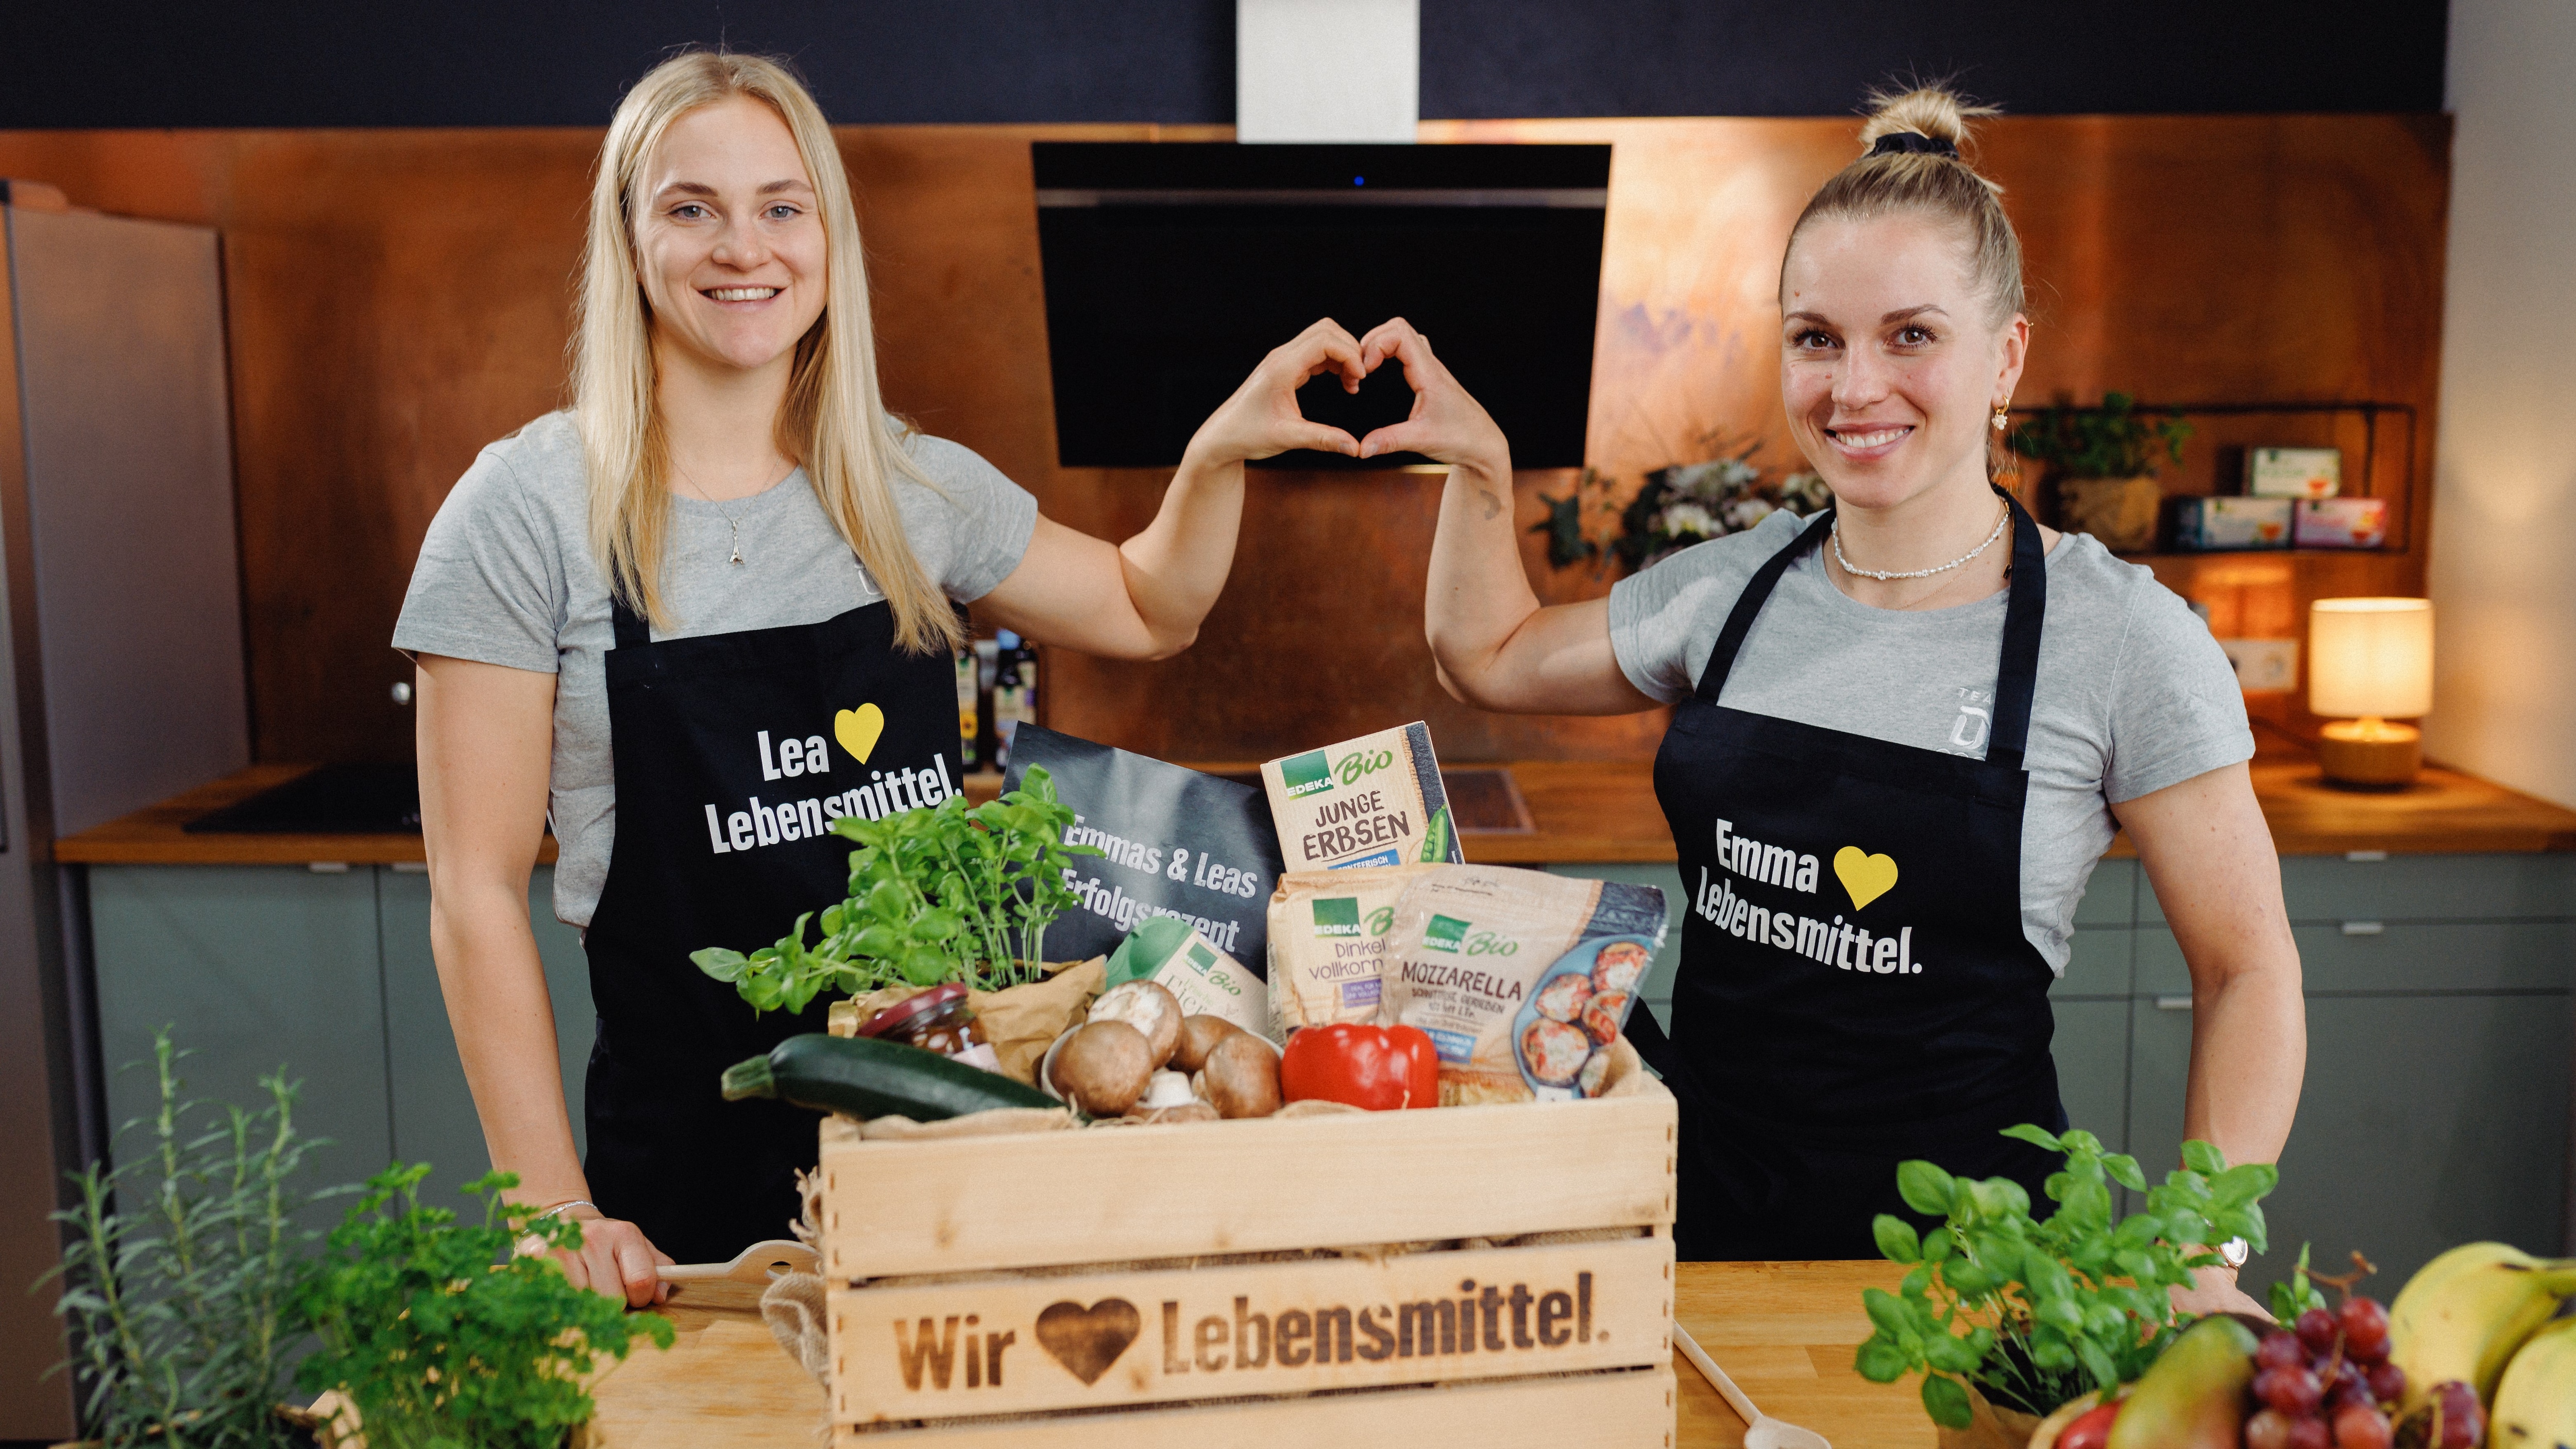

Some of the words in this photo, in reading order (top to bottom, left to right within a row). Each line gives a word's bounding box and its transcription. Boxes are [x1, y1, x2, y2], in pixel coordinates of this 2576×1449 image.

[1959, 687, 1992, 705] TEA
[757, 730, 829, 781] Lea
[1286, 777, 1333, 797] EDEKA
[1334, 749, 1393, 786] Bio
[705, 753, 962, 854] Lebensmittel.
[1315, 791, 1384, 827] JUNGE
[1064, 814, 1162, 874] Emmas
[1166, 848, 1189, 882] &
[1193, 851, 1258, 898] Leas
[1303, 811, 1410, 861] ERBSEN
[1716, 819, 1819, 894] Emma
[1314, 924, 1361, 935] EDEKA
[1696, 865, 1922, 974] Lebensmittel.
[1335, 937, 1386, 958] Dinkel
[1466, 931, 1518, 957] Bio
[1209, 970, 1241, 996] Bio
[1401, 961, 1522, 1000] MOZZARELLA
[893, 1314, 1015, 1391] Wir
[1162, 1271, 1610, 1374] Lebensmittel.
